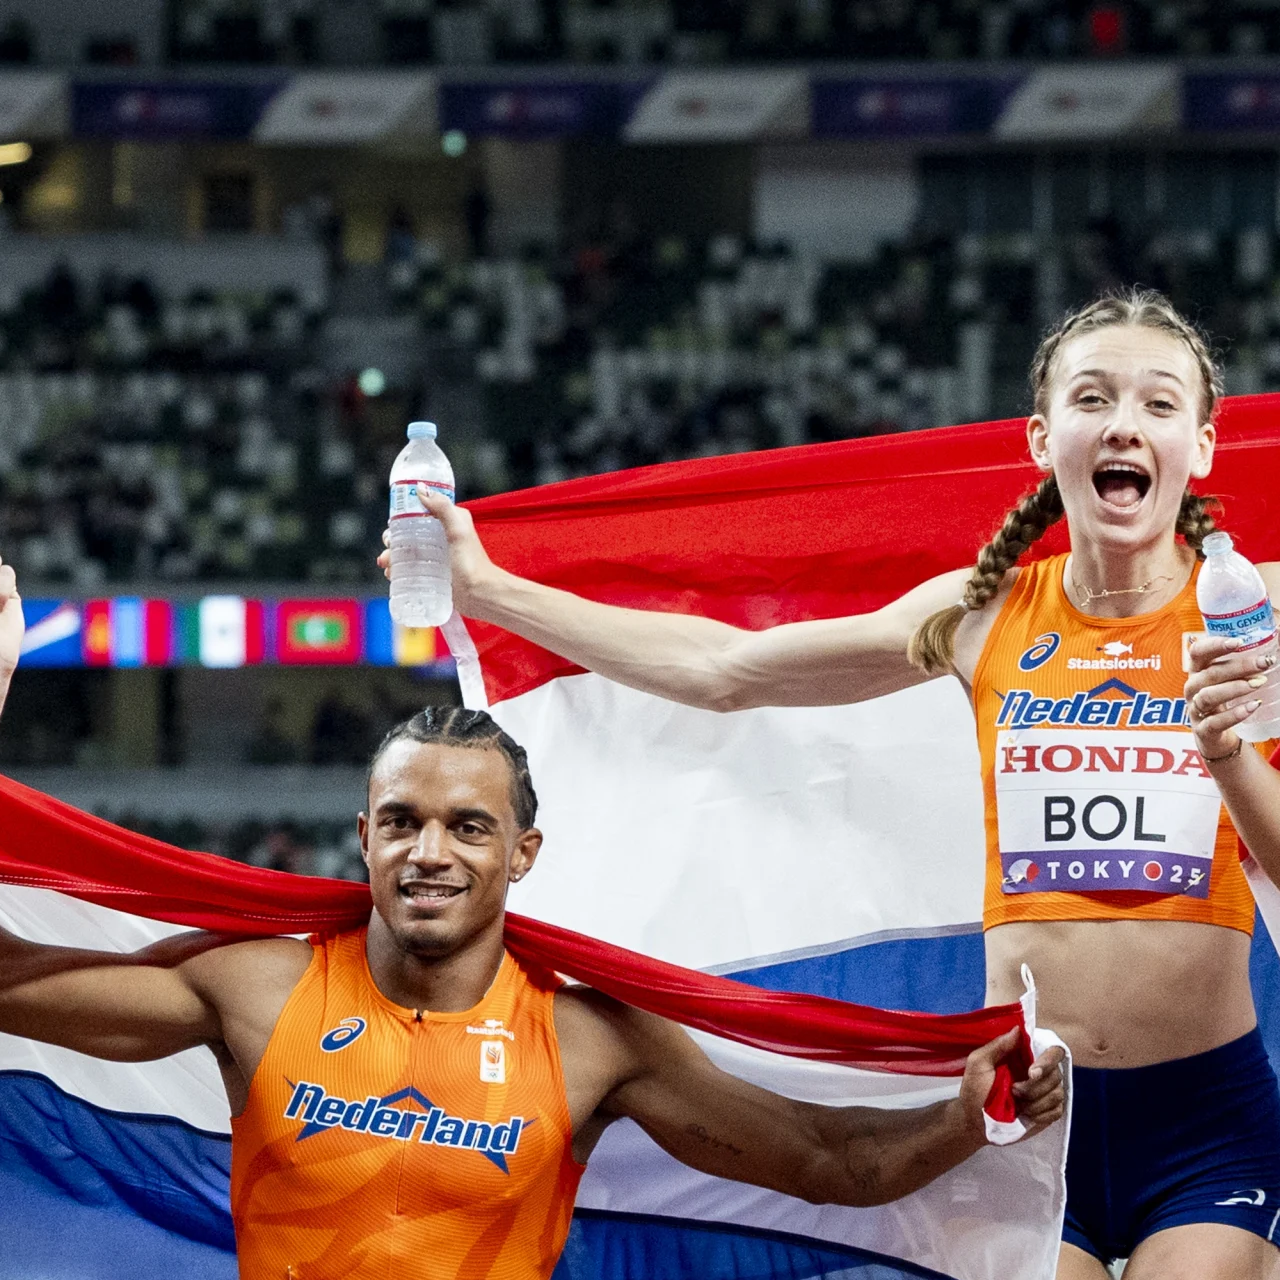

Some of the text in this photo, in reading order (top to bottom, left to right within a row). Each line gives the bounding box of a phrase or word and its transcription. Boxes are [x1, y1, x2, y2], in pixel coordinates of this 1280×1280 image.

[1236, 611, 1266, 629] GEYSER
[1066, 654, 1161, 671] Staatsloterij
[995, 689, 1192, 727] Nederlan
[1001, 745, 1212, 778] HONDA
[1044, 794, 1166, 842] BOL
[283, 1080, 523, 1155] Nederland
